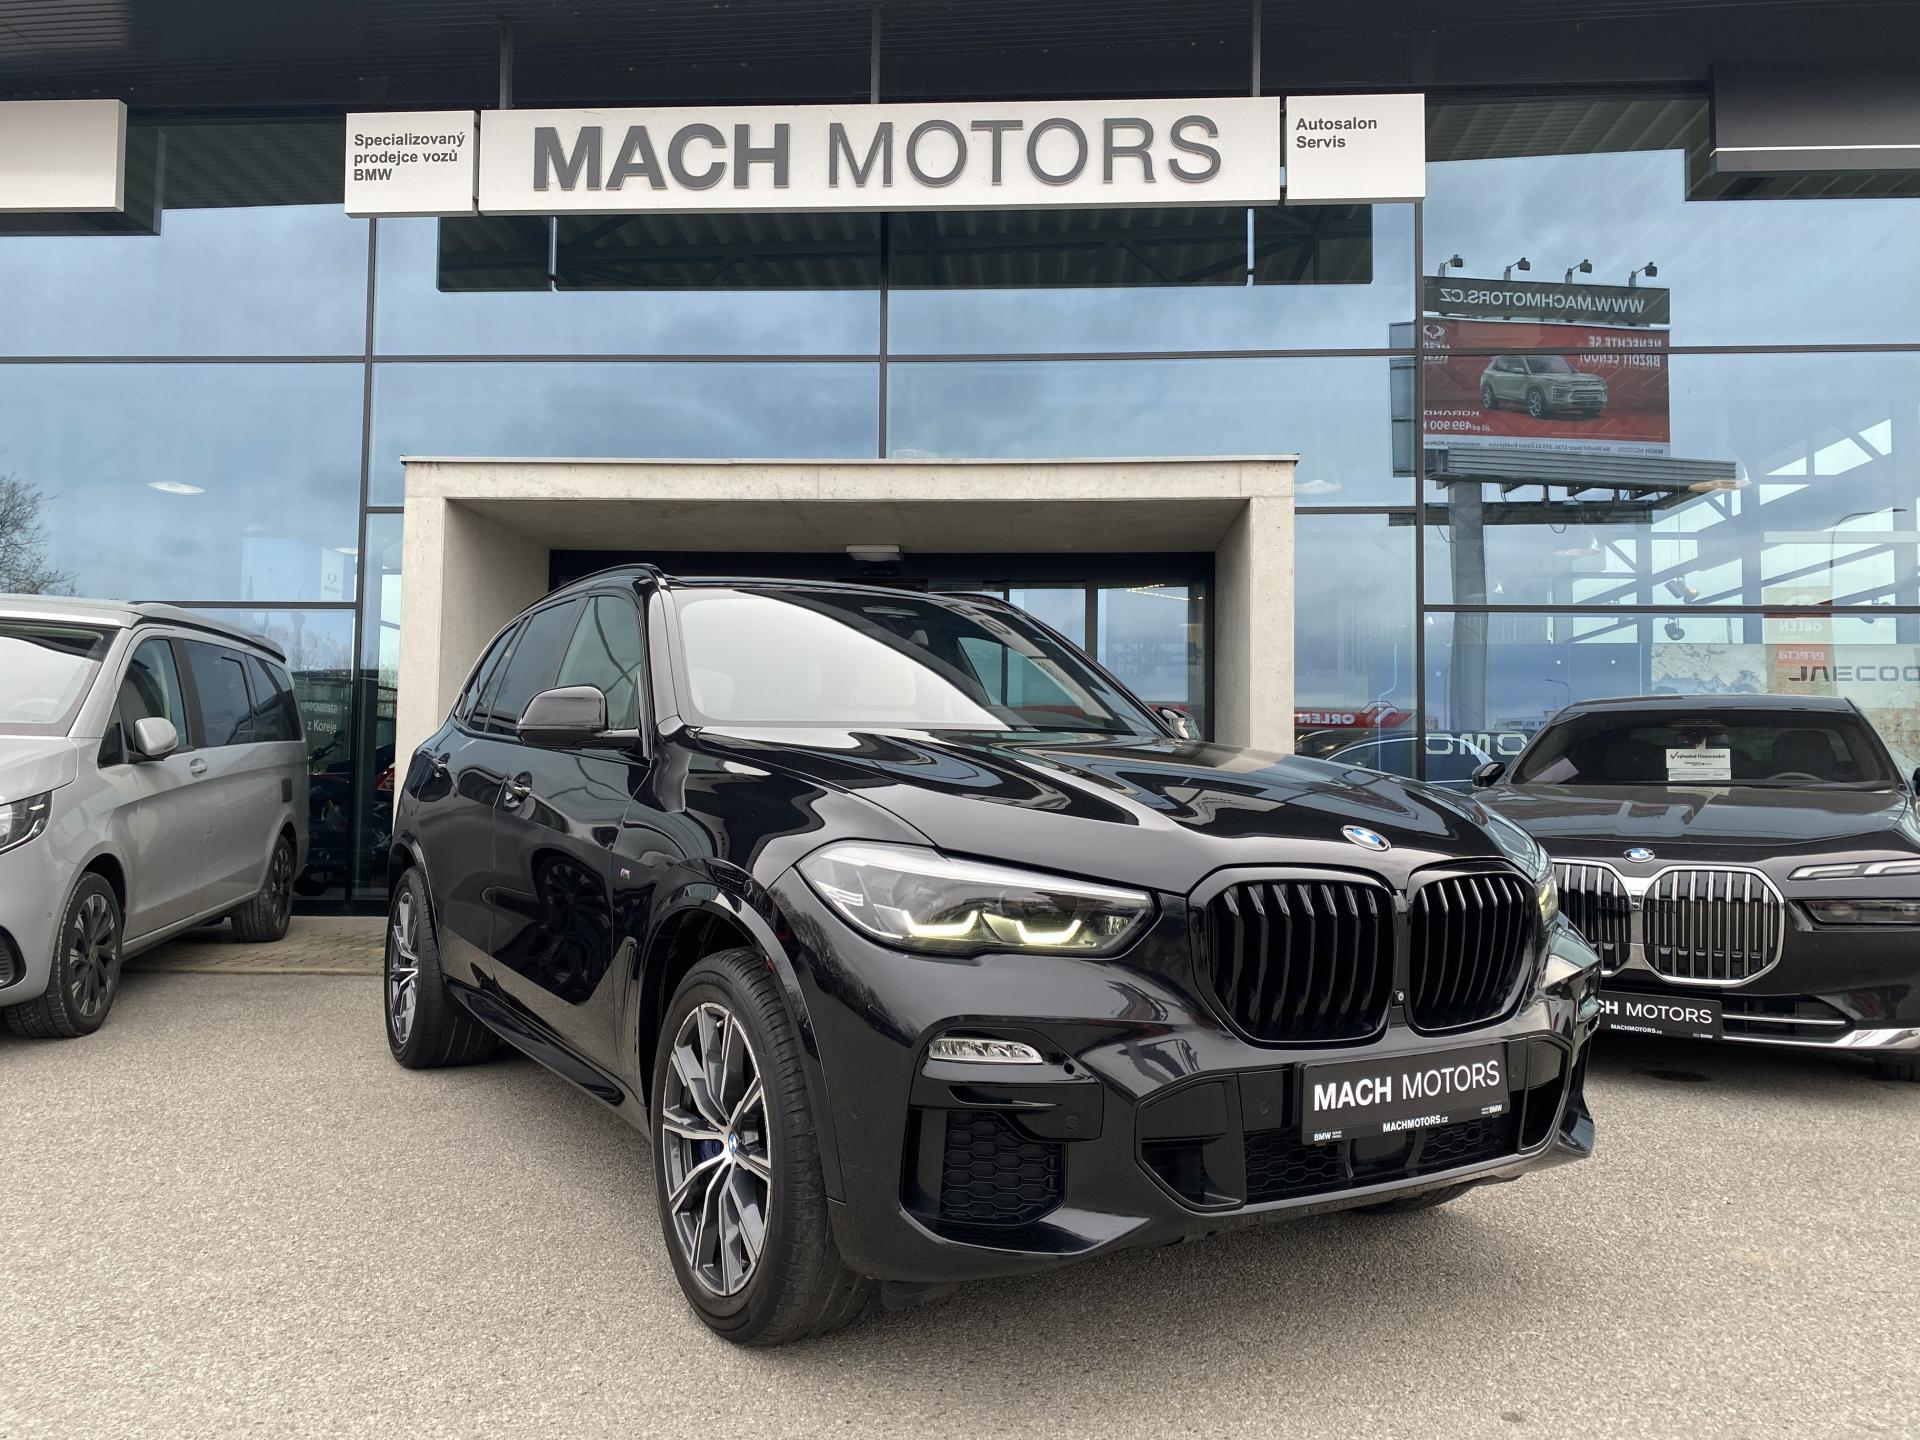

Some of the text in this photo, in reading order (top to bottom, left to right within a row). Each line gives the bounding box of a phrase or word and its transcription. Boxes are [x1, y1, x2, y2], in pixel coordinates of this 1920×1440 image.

[1296, 117, 1378, 131] Autosalon
[354, 132, 466, 149] Specializovaný
[1296, 135, 1347, 149] Servis
[354, 149, 459, 166] prodejce vozů
[533, 114, 1223, 192] MACH MOTORS
[353, 168, 393, 181] BMW
[313, 720, 337, 735] Koreje
[1626, 1002, 1713, 1025] MOTORS
[1314, 1060, 1500, 1112] MACH MOTORS
[1383, 1114, 1449, 1133] MACHMOTORS.cz
[1314, 1131, 1332, 1142] BMW
